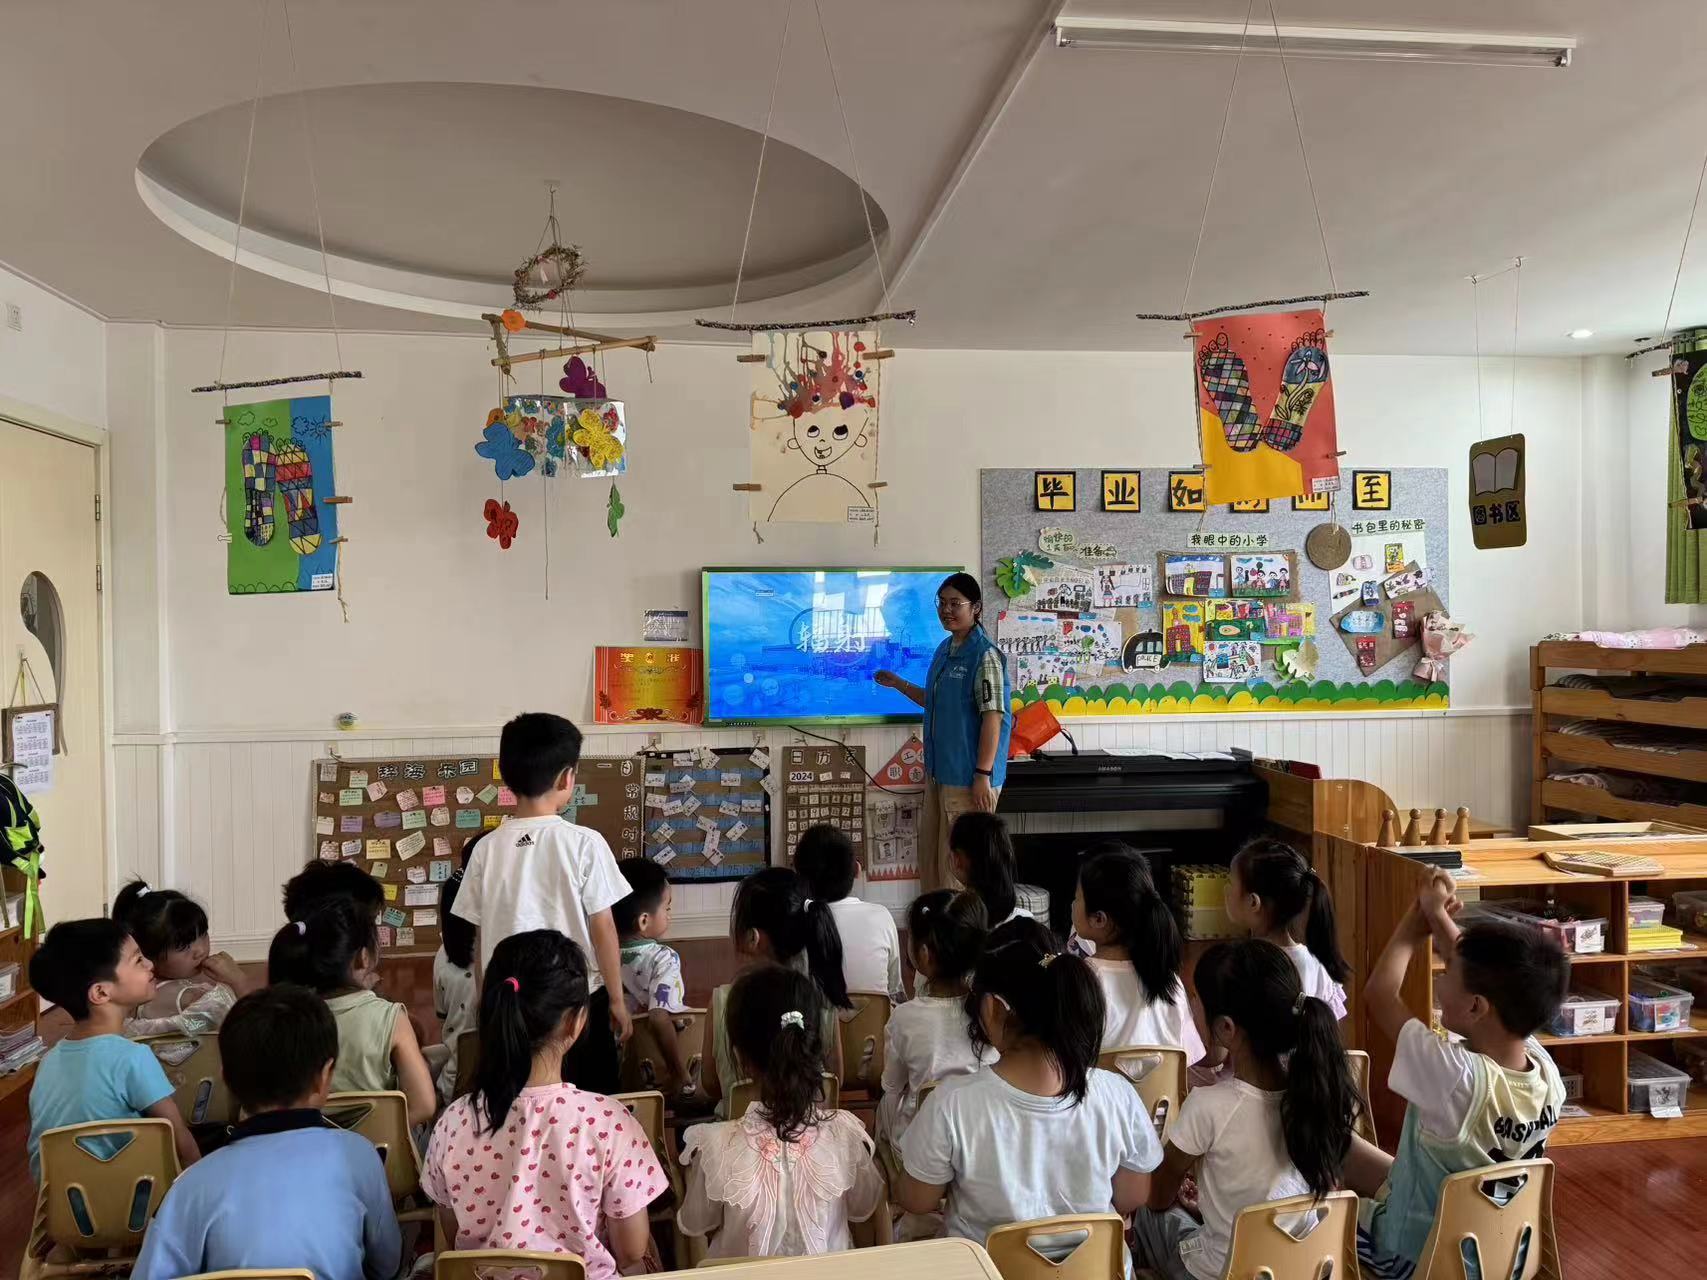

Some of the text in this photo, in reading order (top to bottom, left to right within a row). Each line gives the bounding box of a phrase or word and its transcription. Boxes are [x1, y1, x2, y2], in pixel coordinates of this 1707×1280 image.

[1472, 501, 1520, 525] 图书区
[1352, 519, 1425, 534] 书包里的秘密
[1190, 533, 1268, 547] 我眼中的小学
[791, 773, 812, 781] 2024
